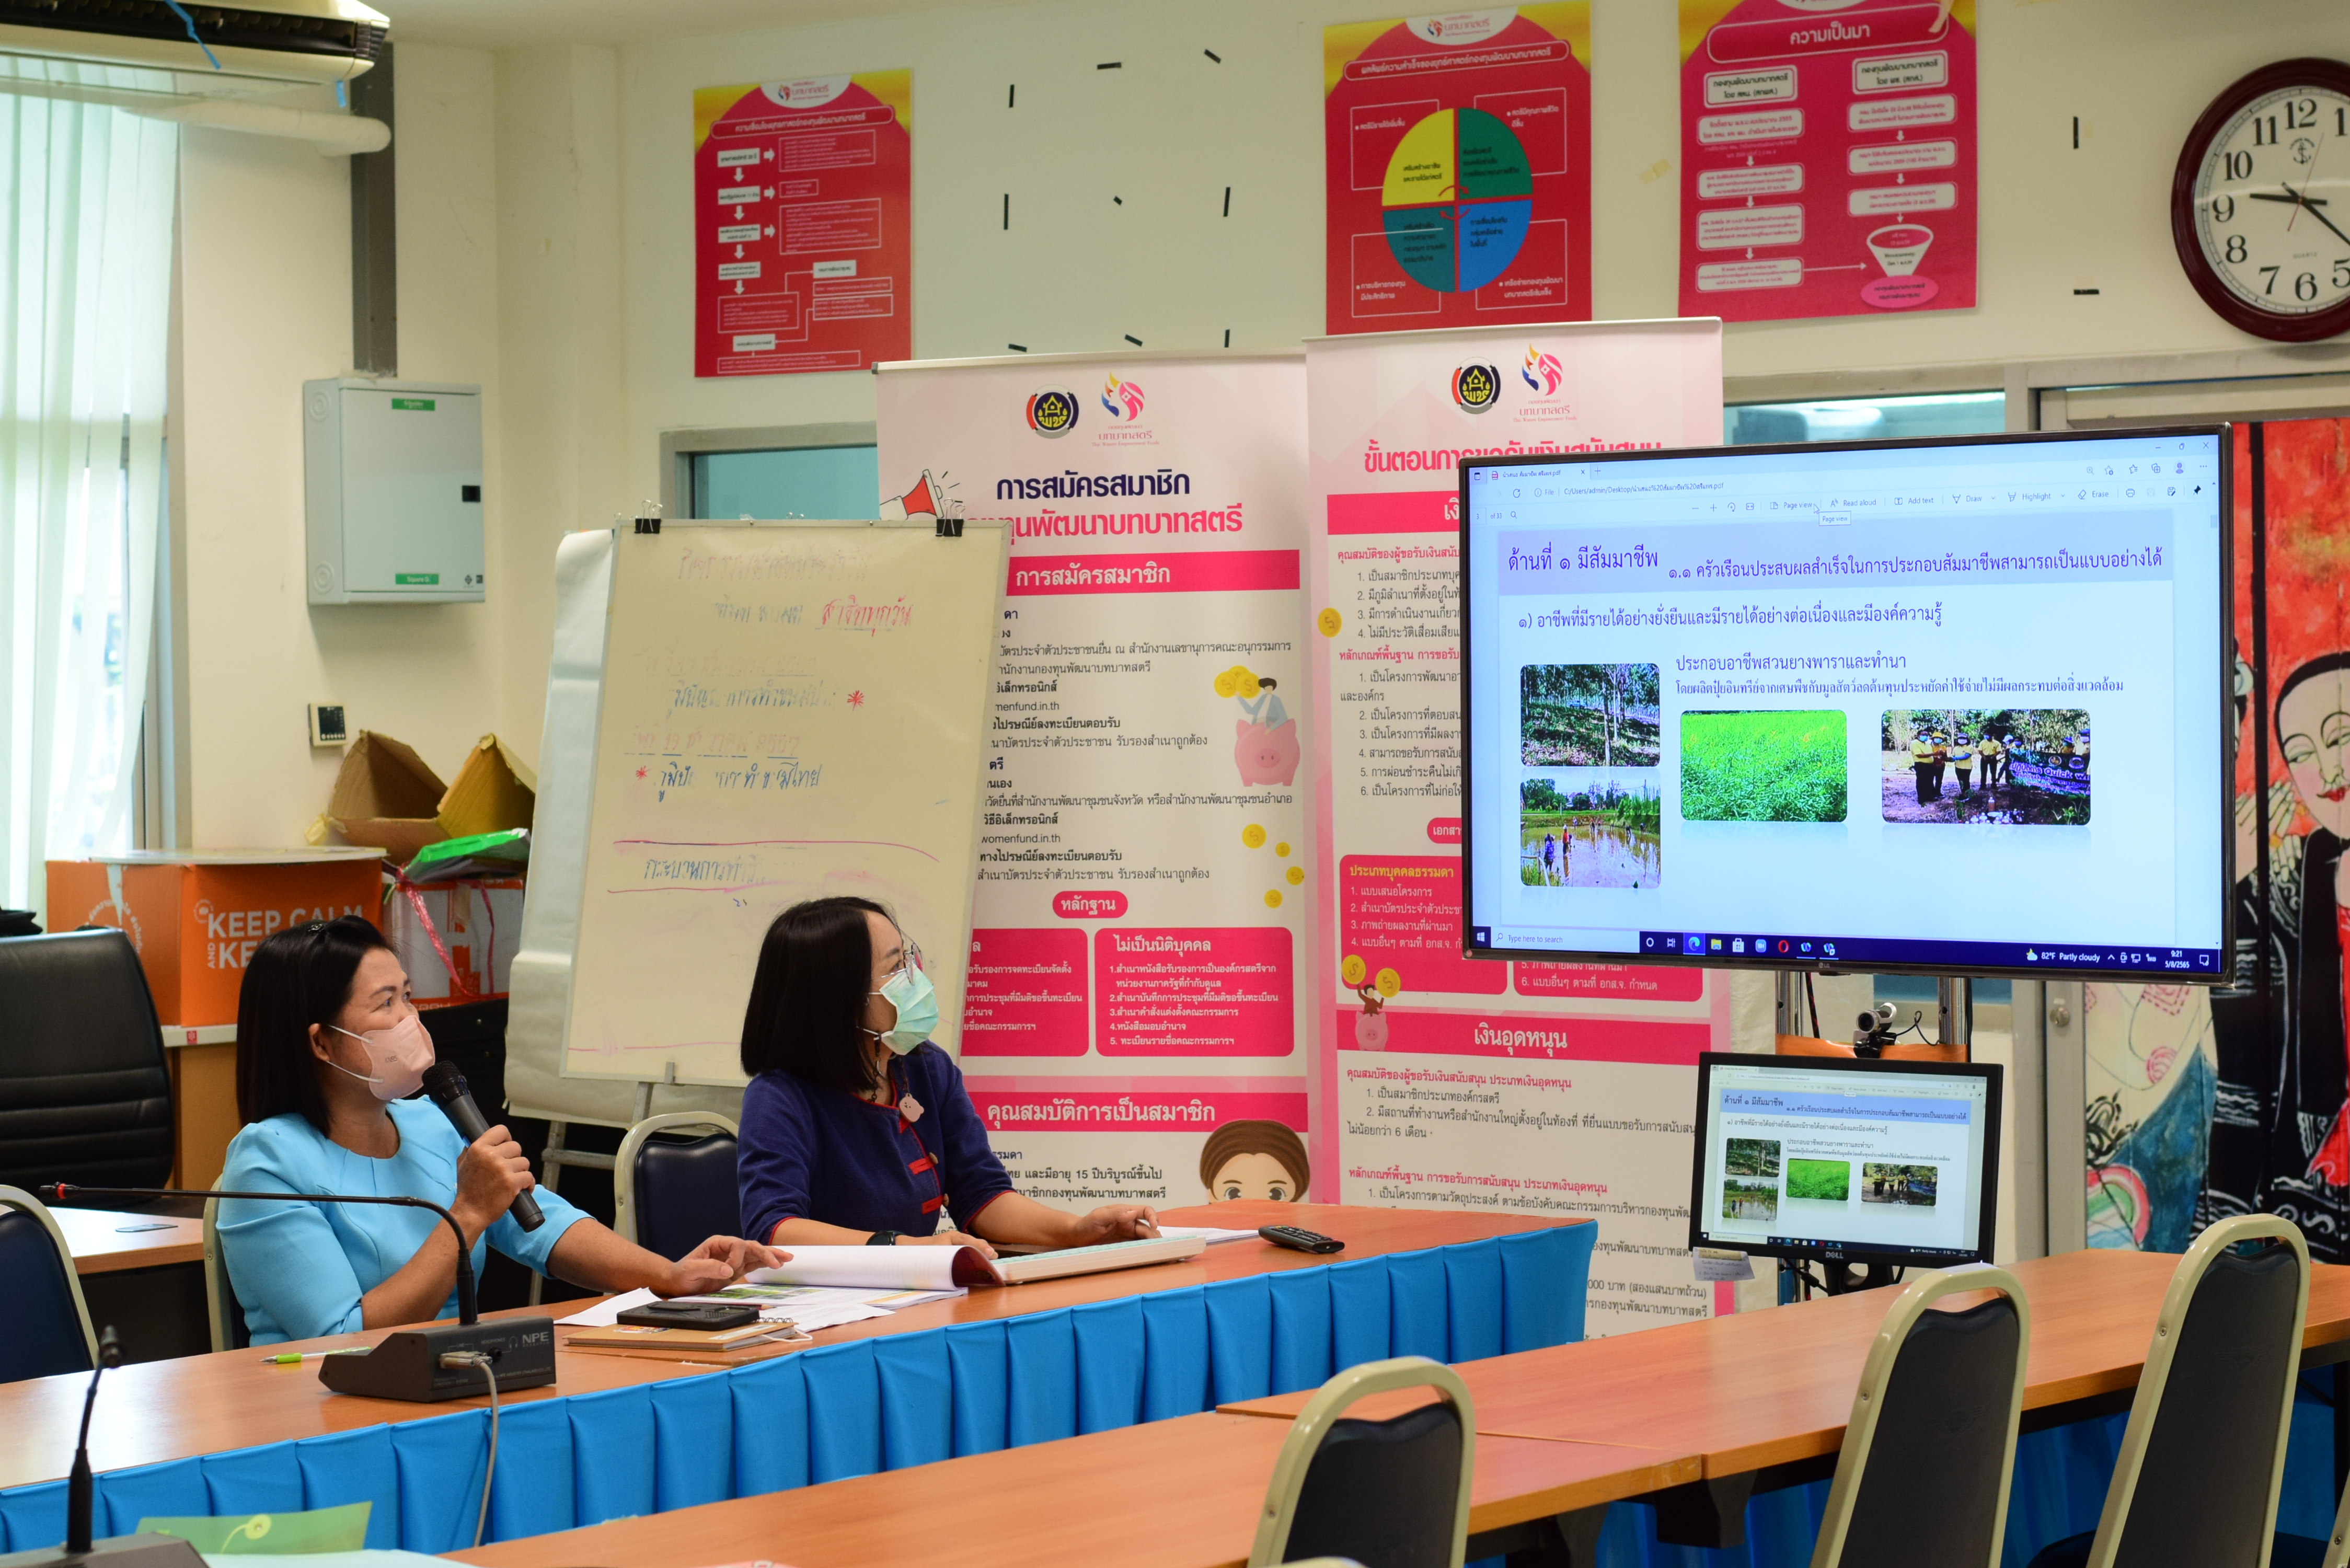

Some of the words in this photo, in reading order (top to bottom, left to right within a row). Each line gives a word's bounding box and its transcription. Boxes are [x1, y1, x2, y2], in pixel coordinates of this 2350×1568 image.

[1790, 21, 1870, 45] ความเป็นมา
[2285, 98, 2318, 130] 12
[2335, 107, 2347, 136] 1
[2253, 116, 2279, 146] 11
[2223, 151, 2253, 180] 10
[2213, 194, 2234, 222] 9
[2226, 235, 2248, 263] 8
[2259, 266, 2280, 295] 7
[2332, 258, 2350, 287] 5
[2295, 272, 2318, 301] 6
[1519, 405, 1570, 416] บทบาทสตรี
[1099, 430, 1152, 440] บทบาทสตรี
[997, 469, 1190, 500] การสมัครสมาชิก
[2022, 492, 2051, 501] Highlight
[1508, 541, 1552, 571] ด้านที่
[1560, 559, 1570, 570] ๑
[1578, 544, 1658, 569] มีสัมมาชีพ
[1668, 567, 1691, 579] ๑.๑
[1697, 546, 2162, 578] ครัวเรือนประสบผลสำเร็จในการประกอบสัมมาชีพสามารถเป็นแบบอย่างได้
[1016, 561, 1171, 587] การสมัครสมาชิก
[1358, 572, 1364, 582] 1.
[1357, 591, 1365, 601] 2.
[1357, 610, 1365, 619] 3.
[1518, 613, 1533, 629] ๑)
[1538, 600, 1942, 627] อาชีพที่มีรายได้อย่างยั่งยืนและมีรายได้อย่างต่อเนื่องและมีองค์ความรู้
[1357, 628, 1365, 638] 4.
[1115, 645, 1125, 655] ณ
[1129, 641, 1291, 656] สำนักงานเลขานุการคณะอนุกรรมการ
[1339, 645, 1414, 664] หลักเกณฑ์พื้นฐาน
[1676, 651, 1906, 671] ประกอบอาชีพสวนยางพาราและทำนา
[1360, 673, 1366, 682] 1.
[1340, 688, 1384, 702] และองค์กร
[1359, 711, 1367, 720] 2.
[1116, 733, 1207, 750] รับรองสำเนาถูกต้อง
[1360, 730, 1367, 739] 3.
[1359, 749, 1366, 758] 4.
[1361, 768, 1368, 777] 5.
[1361, 787, 1368, 796] 6.
[1147, 792, 1293, 809] หรือสำนักงานพัฒนาชุมชนอำเภอ
[984, 812, 1058, 825] วิธีอิเล็กทรอนิกส์
[980, 848, 1122, 862] ทางไปรษณีย์ลงทะเบียนตอบรับ
[978, 868, 1113, 881] สำเนาบัตรประจำตัวประชาชน
[1118, 866, 1209, 882] รับรองสำเนาถูกต้อง
[1350, 866, 1454, 881] ประเภทบุคคลธรรมดา
[1351, 887, 1357, 895] 1.
[1361, 884, 1432, 897] แบบเสนอโครงการ
[1061, 896, 1116, 915] หลักฐาน
[1351, 904, 1358, 913] 2.
[208, 910, 281, 939] KEEP
[1351, 920, 1358, 929] 3.
[1361, 916, 1453, 931] ภาพถ่ายผลงานที่ผ่านมา
[1114, 933, 1212, 957] ไม่เป็นนิติบุคคล
[1351, 938, 1358, 946] 4.
[1362, 932, 1396, 949] แบบอื่นๆ
[1400, 935, 1422, 948] ตามที่
[1426, 940, 1452, 949] อกส.จ.
[2041, 952, 2056, 960] 82°F
[2059, 953, 2077, 962] Partly
[2079, 953, 2100, 963] cloudy
[1116, 975, 1222, 991] หน่วยงานภาครัฐที่กำกับดูแล
[1533, 973, 1569, 989] แบบอื่นๆ
[1573, 974, 1596, 988] ตามที่
[1600, 981, 1626, 989] อกส.จ.
[1629, 980, 1657, 990] กำหนด
[1109, 989, 1278, 1006] 2.สำเนาบันทึกการประชุมที่มีมติขอขึ้นทะเบียน
[1109, 1004, 1238, 1017] 3.สำเนาคำสั่งแต่งตั้งคณะกรรมการ
[1109, 1020, 1186, 1032] 4.หนังสือมอบอำนาจ
[1110, 1036, 1118, 1045] 5.
[1120, 1033, 1235, 1046] ทะเบียนรายชื่อคณะกรรมการฯ
[1474, 1022, 1568, 1057] เงินอุดหนุน
[1347, 1066, 1487, 1087] คุณสมบัติของผู้ขอรับเงินสนับสนุน
[1490, 1071, 1572, 1089] ประเภทเงินอุดหนุน
[1367, 1088, 1374, 1098] 1.
[1377, 1087, 1500, 1104] เป็นสมาชิกประเภทองค์กรสตรี
[1724, 1094, 1742, 1104] ด้านที่
[1752, 1097, 1783, 1106] มีสัมมาชีพ
[987, 1097, 1216, 1129] คุณสมบัติการเป็นสมาชิก
[1366, 1107, 1374, 1117] 2.
[1378, 1105, 1579, 1129] มีสถานที่ทำงานหรือสำนักงานใหญ่ตั้งอยู่ในท้องที่
[1347, 1122, 1391, 1137] ไม่น้อยกว่า
[1395, 1127, 1401, 1137] 6
[1404, 1125, 1427, 1138] เดือน
[1025, 1169, 1071, 1183] และมีอายุ
[1076, 1170, 1088, 1179] 15
[1093, 1164, 1162, 1183] ปีบริบูรณ์ขึ้นไป
[1349, 1165, 1423, 1183] หลักเกณฑ์พื้นฐาน
[1427, 1171, 1520, 1190] การขอรับการสนับสนุน
[1524, 1177, 1608, 1197] ประเภทเงินอุดหนุน
[1369, 1189, 1376, 1198] 1.
[1379, 1186, 1499, 1207] เป็นโครงการตามวัตถุประสงค์
[1608, 1281, 1626, 1292] บาท
[1629, 1281, 1707, 1300] (สองแสนบาทถ้วน)
[523, 1332, 549, 1344] NPE
